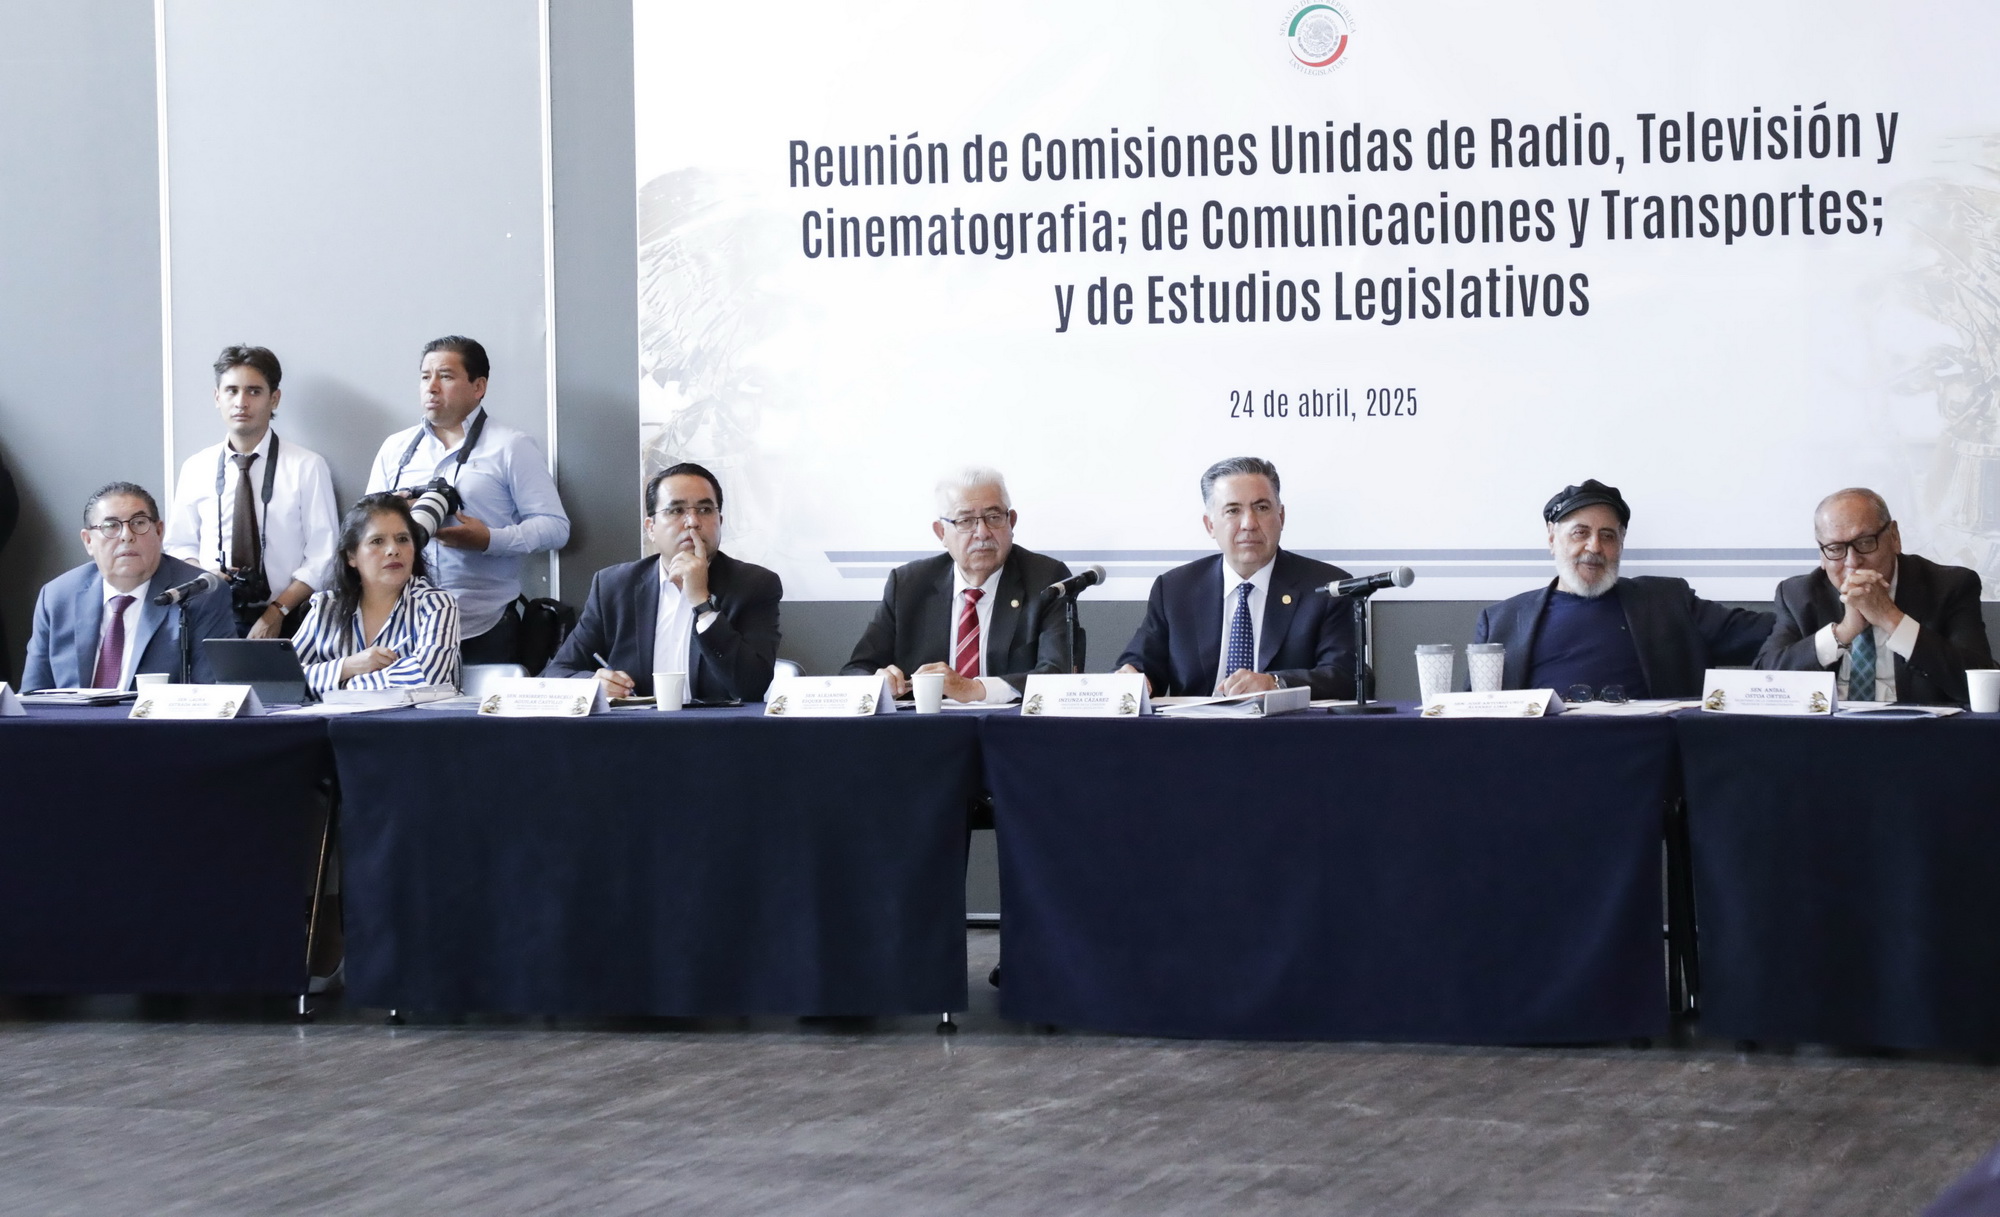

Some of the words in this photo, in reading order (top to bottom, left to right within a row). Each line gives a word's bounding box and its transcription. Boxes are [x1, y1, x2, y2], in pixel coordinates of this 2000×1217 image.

[789, 131, 949, 188] Reunión
[963, 134, 1008, 183] de
[1022, 126, 1258, 182] Comisiones
[1271, 120, 1413, 175] Unidas
[1427, 119, 1475, 171] de
[1490, 112, 1625, 175] Radio,
[1636, 101, 1861, 164] Televisión
[1875, 111, 1899, 165] y
[1141, 201, 1188, 251] de
[1202, 191, 1556, 250] Comunicaciones
[1567, 197, 1590, 249] y
[1601, 184, 1883, 246] Transportes;
[1054, 284, 1075, 333] y
[1087, 276, 1133, 326] de
[1148, 270, 1321, 325] Estudios
[1335, 264, 1590, 326] Legislativos
[1230, 390, 1255, 418] 24
[1263, 389, 1288, 418] de
[1298, 387, 1355, 423] abril,
[1366, 387, 1417, 417] 2025
